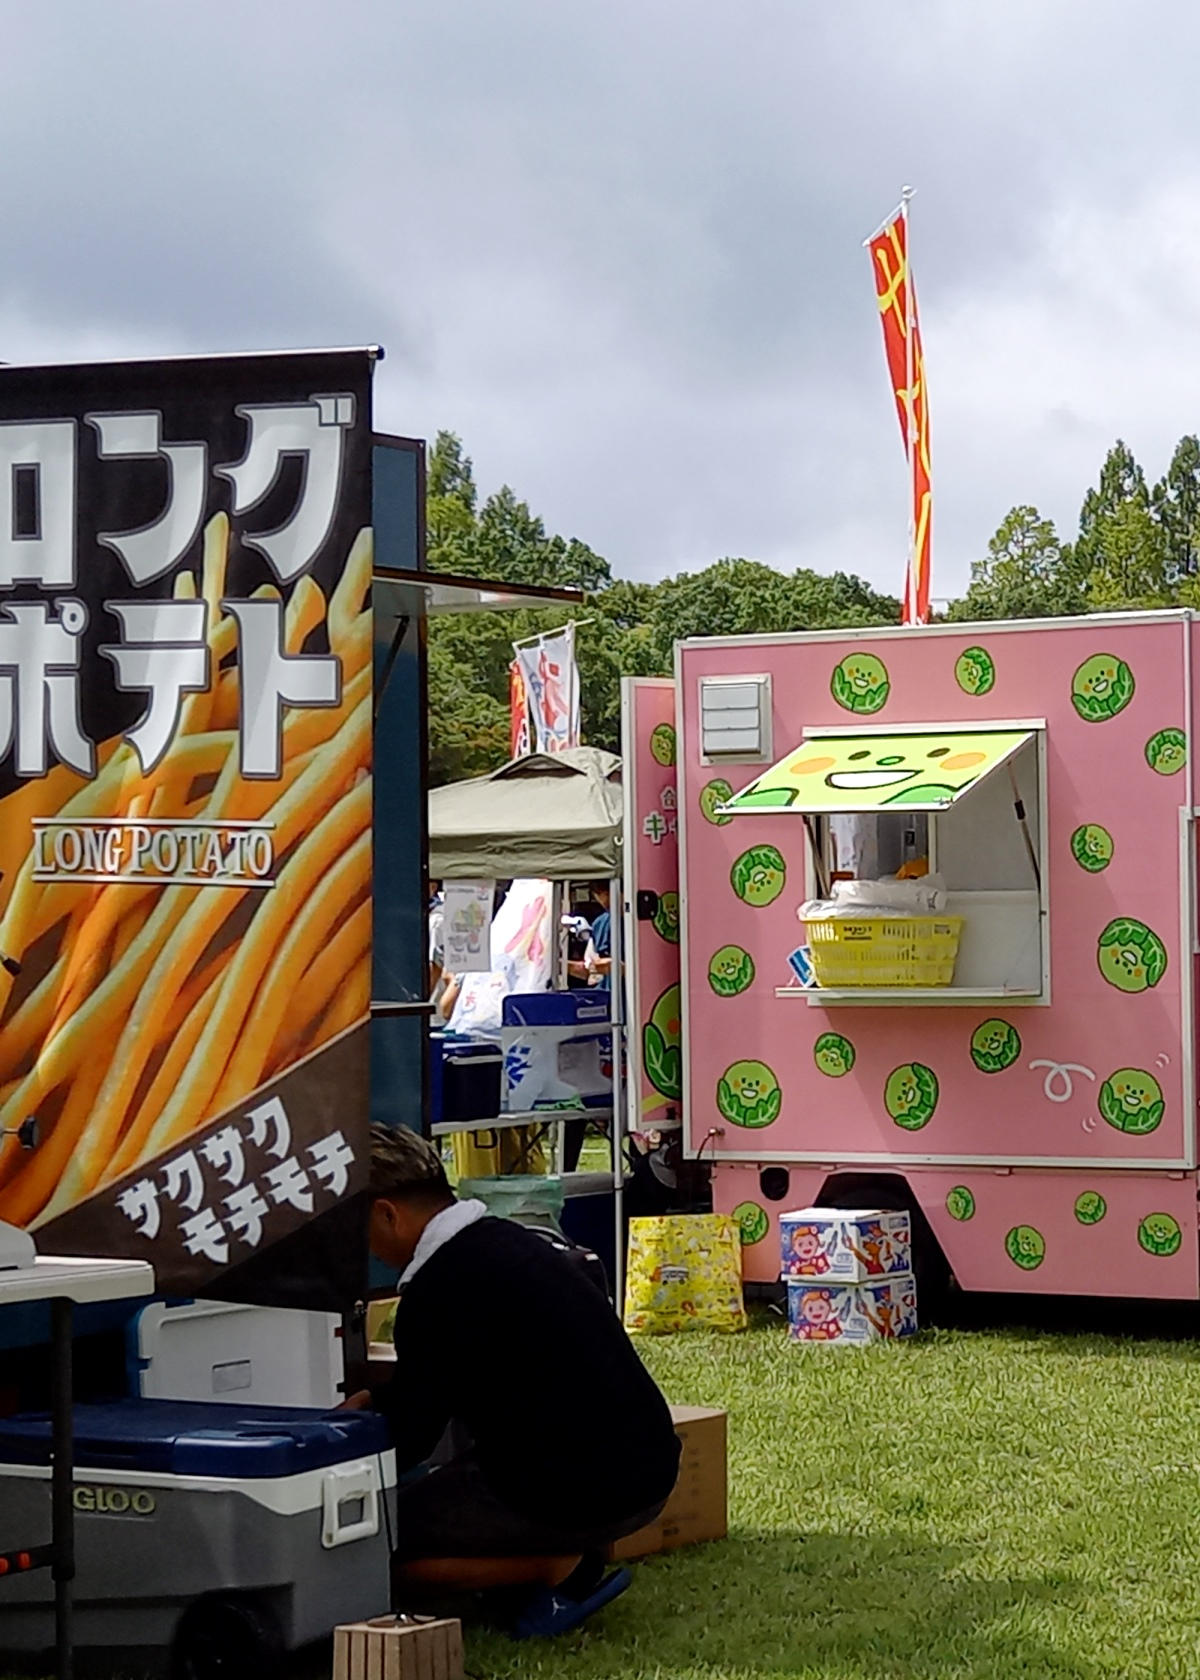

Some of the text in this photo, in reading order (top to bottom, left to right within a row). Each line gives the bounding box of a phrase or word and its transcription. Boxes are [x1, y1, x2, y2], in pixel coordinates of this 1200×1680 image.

[0, 393, 356, 589] ロング
[0, 597, 342, 780] ポテト
[33, 827, 274, 877] LONG POTATO
[117, 1096, 294, 1240] サクサク
[177, 1130, 356, 1265] モチモチ
[72, 1486, 156, 1515] GLOO
